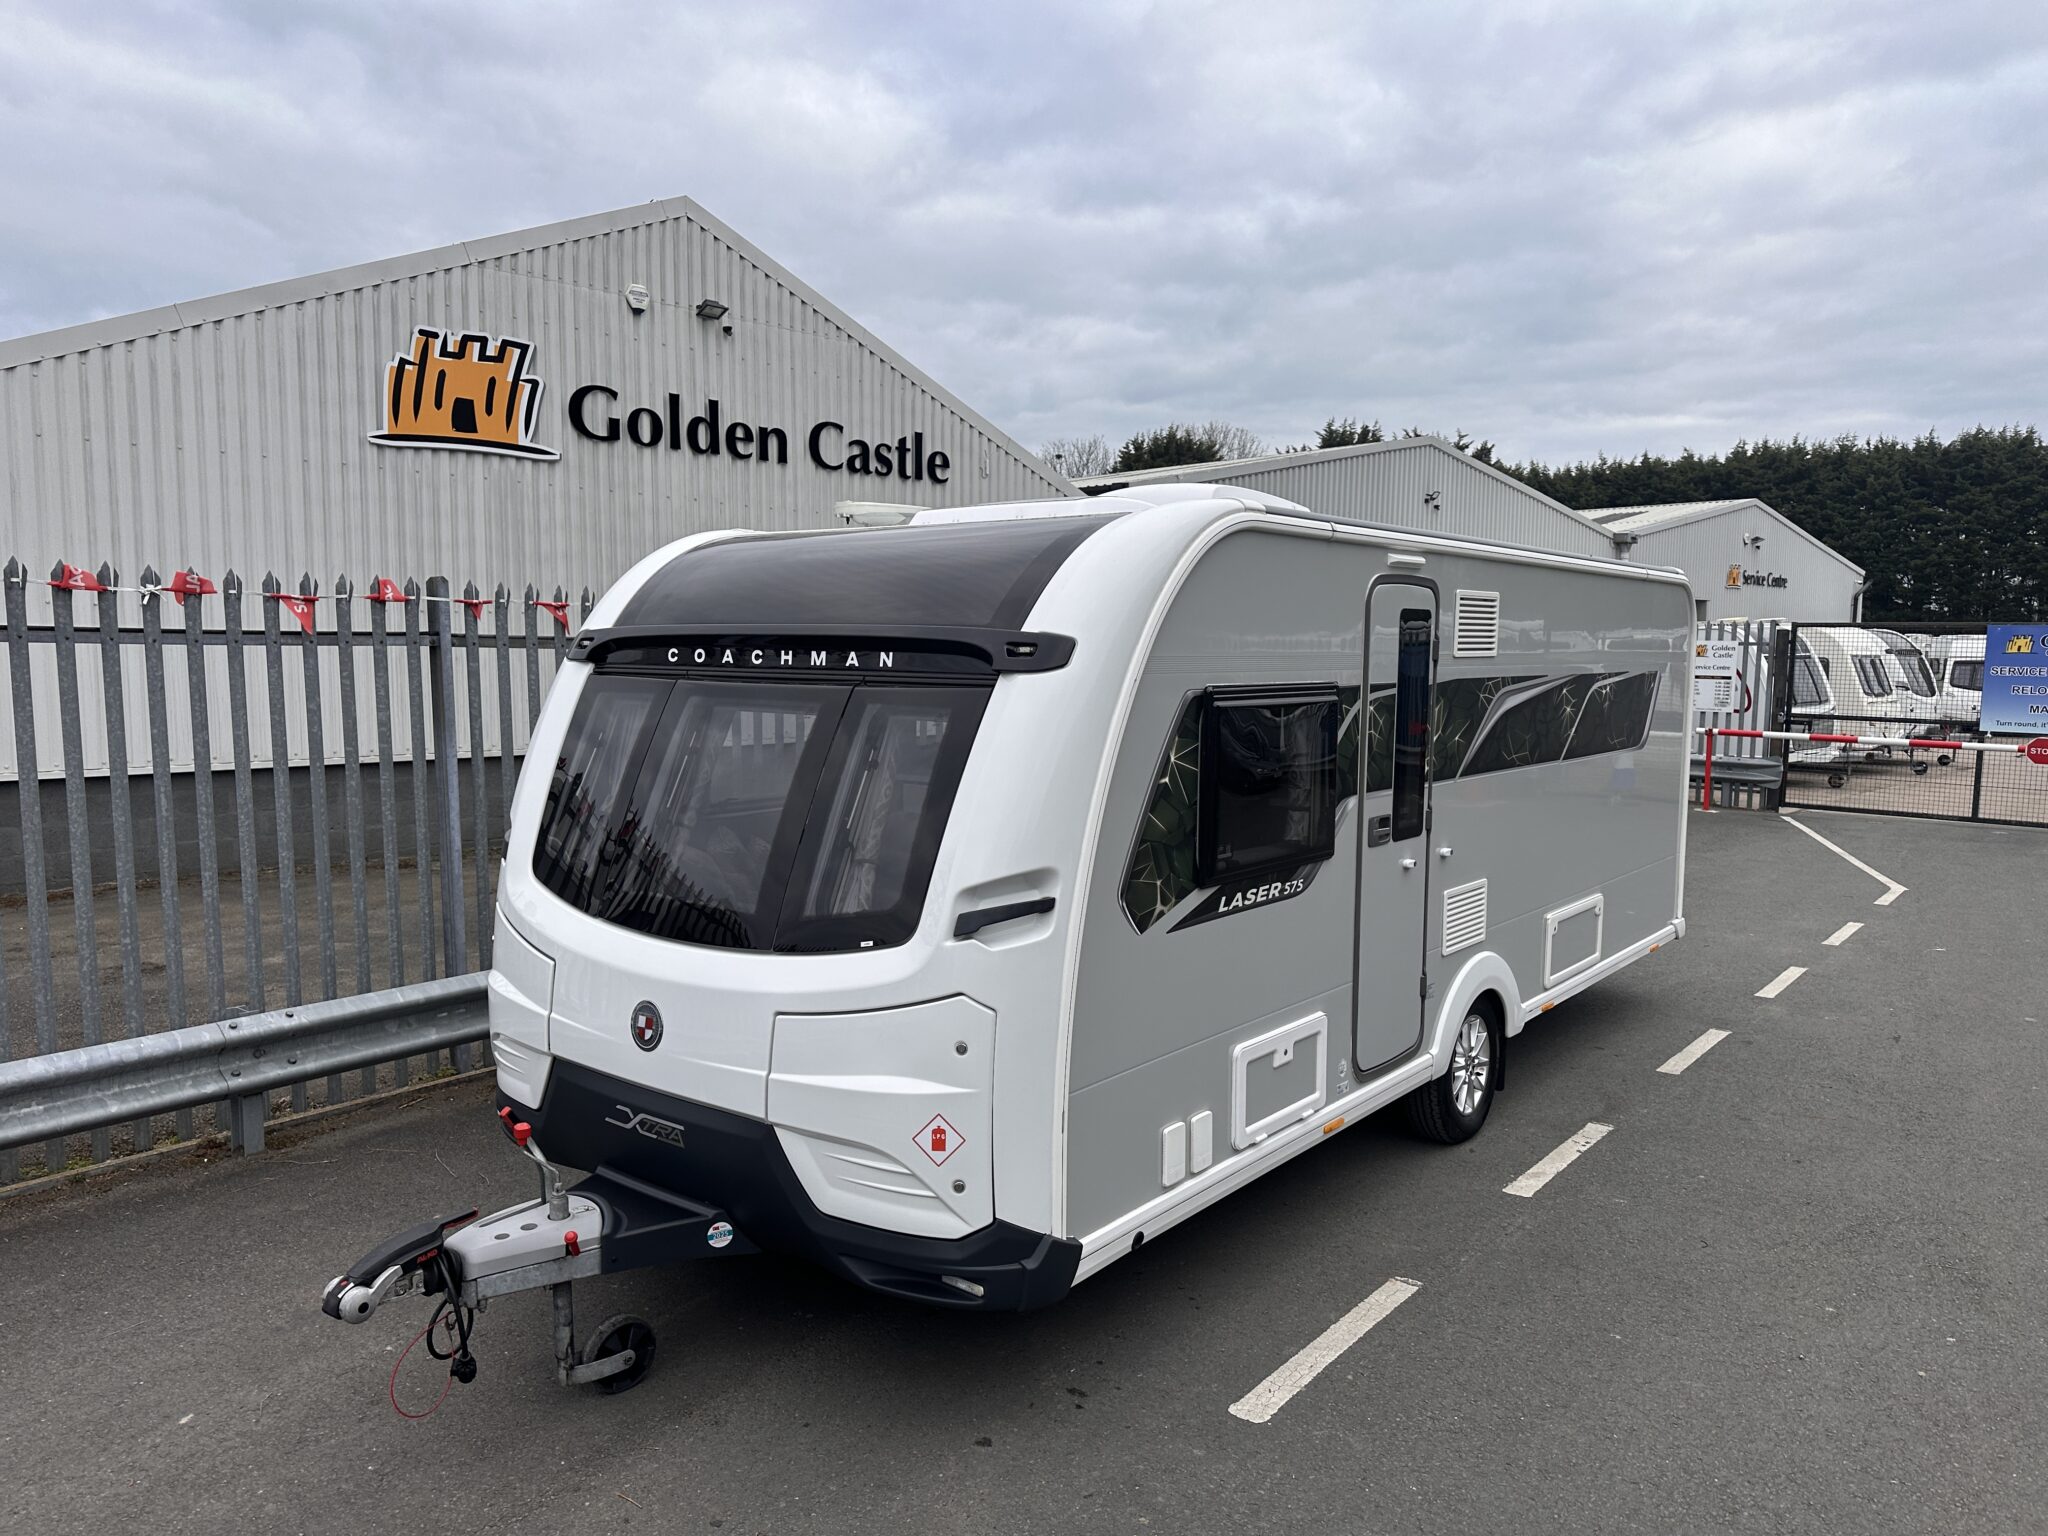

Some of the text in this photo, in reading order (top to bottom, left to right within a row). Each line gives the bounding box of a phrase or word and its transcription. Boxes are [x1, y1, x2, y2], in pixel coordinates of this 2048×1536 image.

[568, 384, 951, 484] Golden Castle
[1742, 569, 1788, 588] Service Centre
[1711, 644, 1736, 652] Golden
[667, 648, 894, 667] COACHMAN
[1712, 651, 1734, 659] Castle
[1990, 665, 2047, 677] SERVICE
[2014, 721, 2039, 729] round,
[1218, 879, 1304, 913] LASER 575
[713, 1231, 729, 1240] 2025
